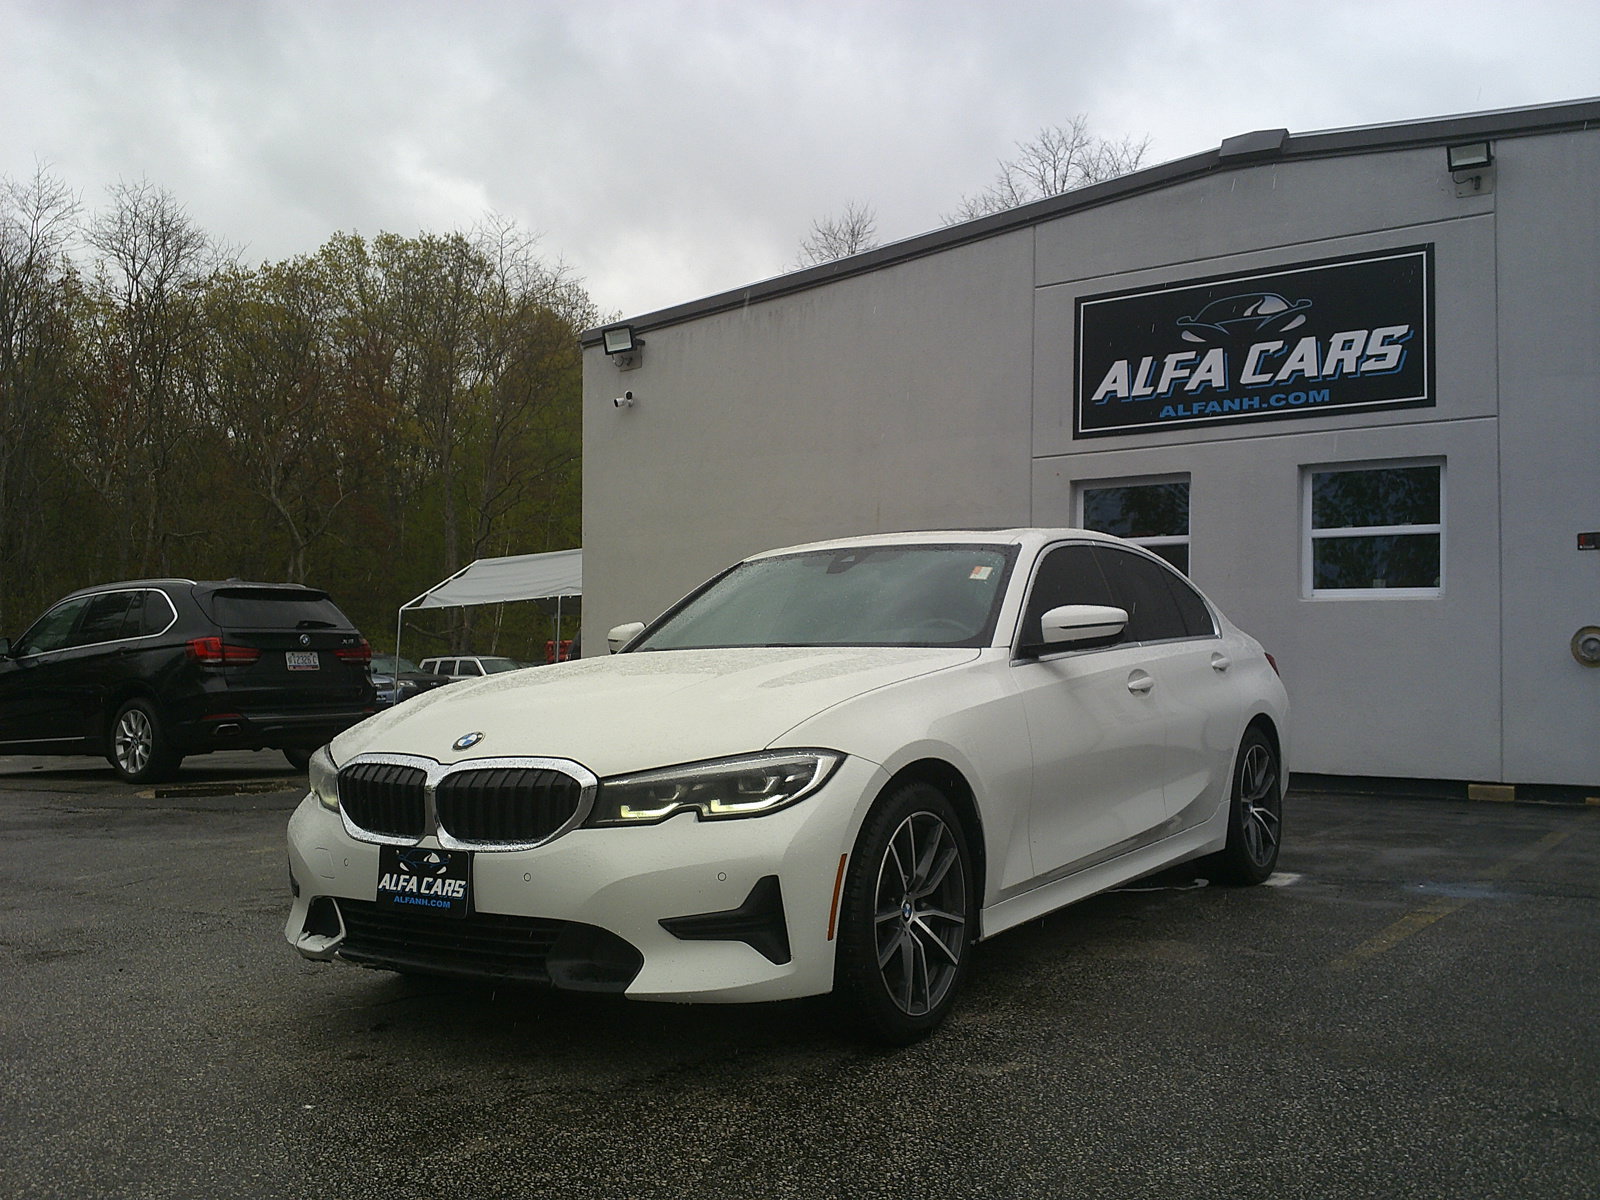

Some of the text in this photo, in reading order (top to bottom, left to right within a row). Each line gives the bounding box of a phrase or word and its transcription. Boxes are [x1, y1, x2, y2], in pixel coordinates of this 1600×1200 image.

[1092, 324, 1411, 402] ALFA CARS
[1160, 389, 1330, 417] ALFANH.COM
[378, 873, 467, 898] ALFA CARS
[393, 895, 451, 909] ALFANH.COM
